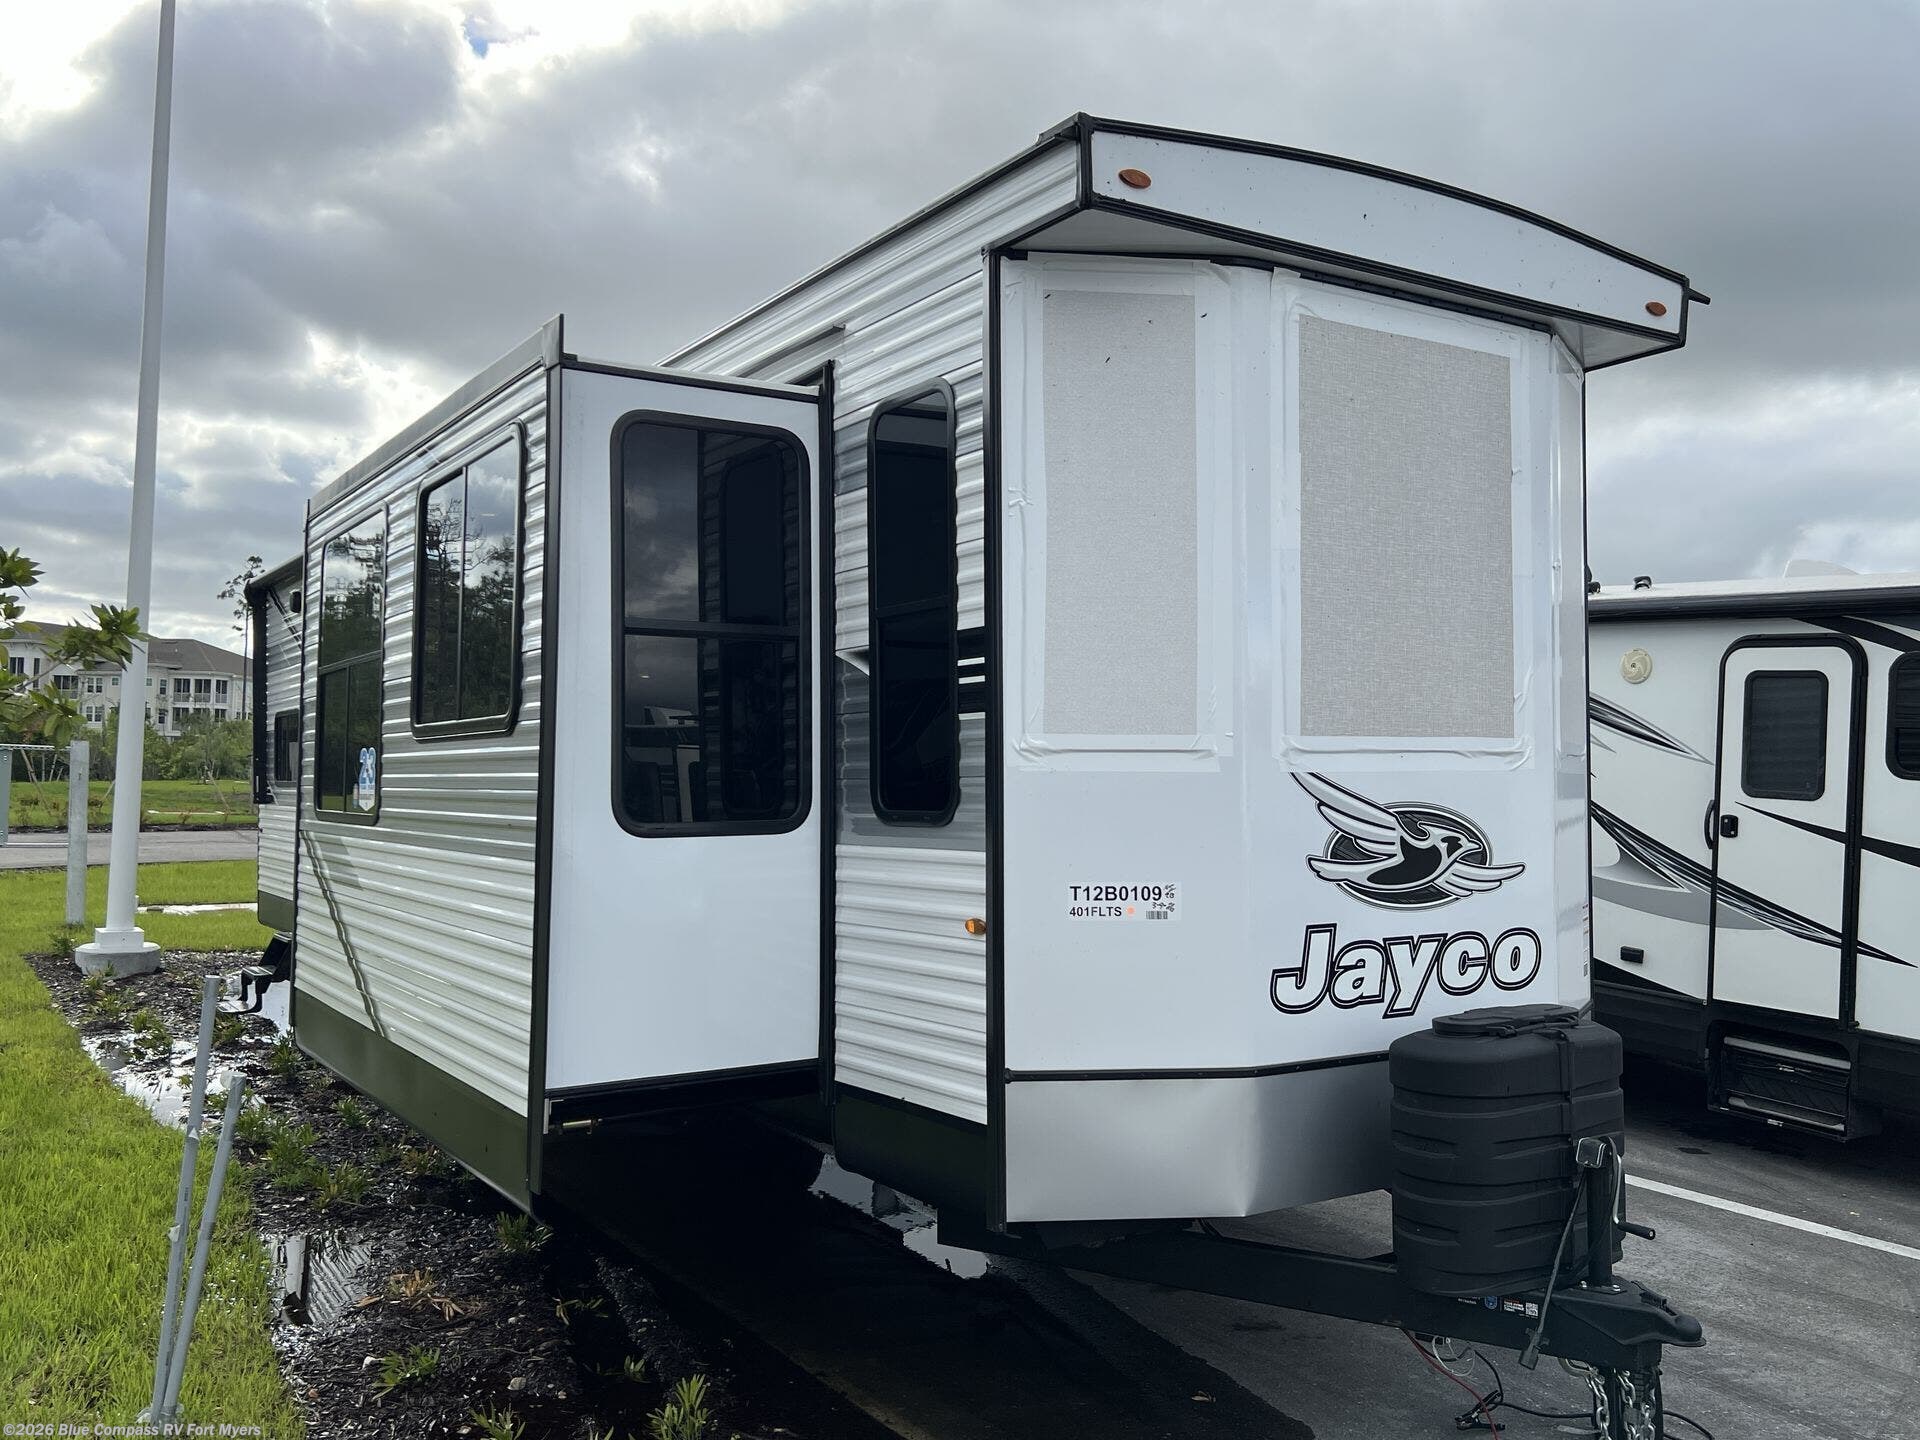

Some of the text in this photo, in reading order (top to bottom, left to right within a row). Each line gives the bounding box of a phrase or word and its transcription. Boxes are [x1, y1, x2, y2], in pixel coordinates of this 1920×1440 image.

[1069, 885, 1162, 901] T12B0109
[1069, 906, 1122, 917] 401FLTS
[1270, 923, 1541, 1019] Jayco
